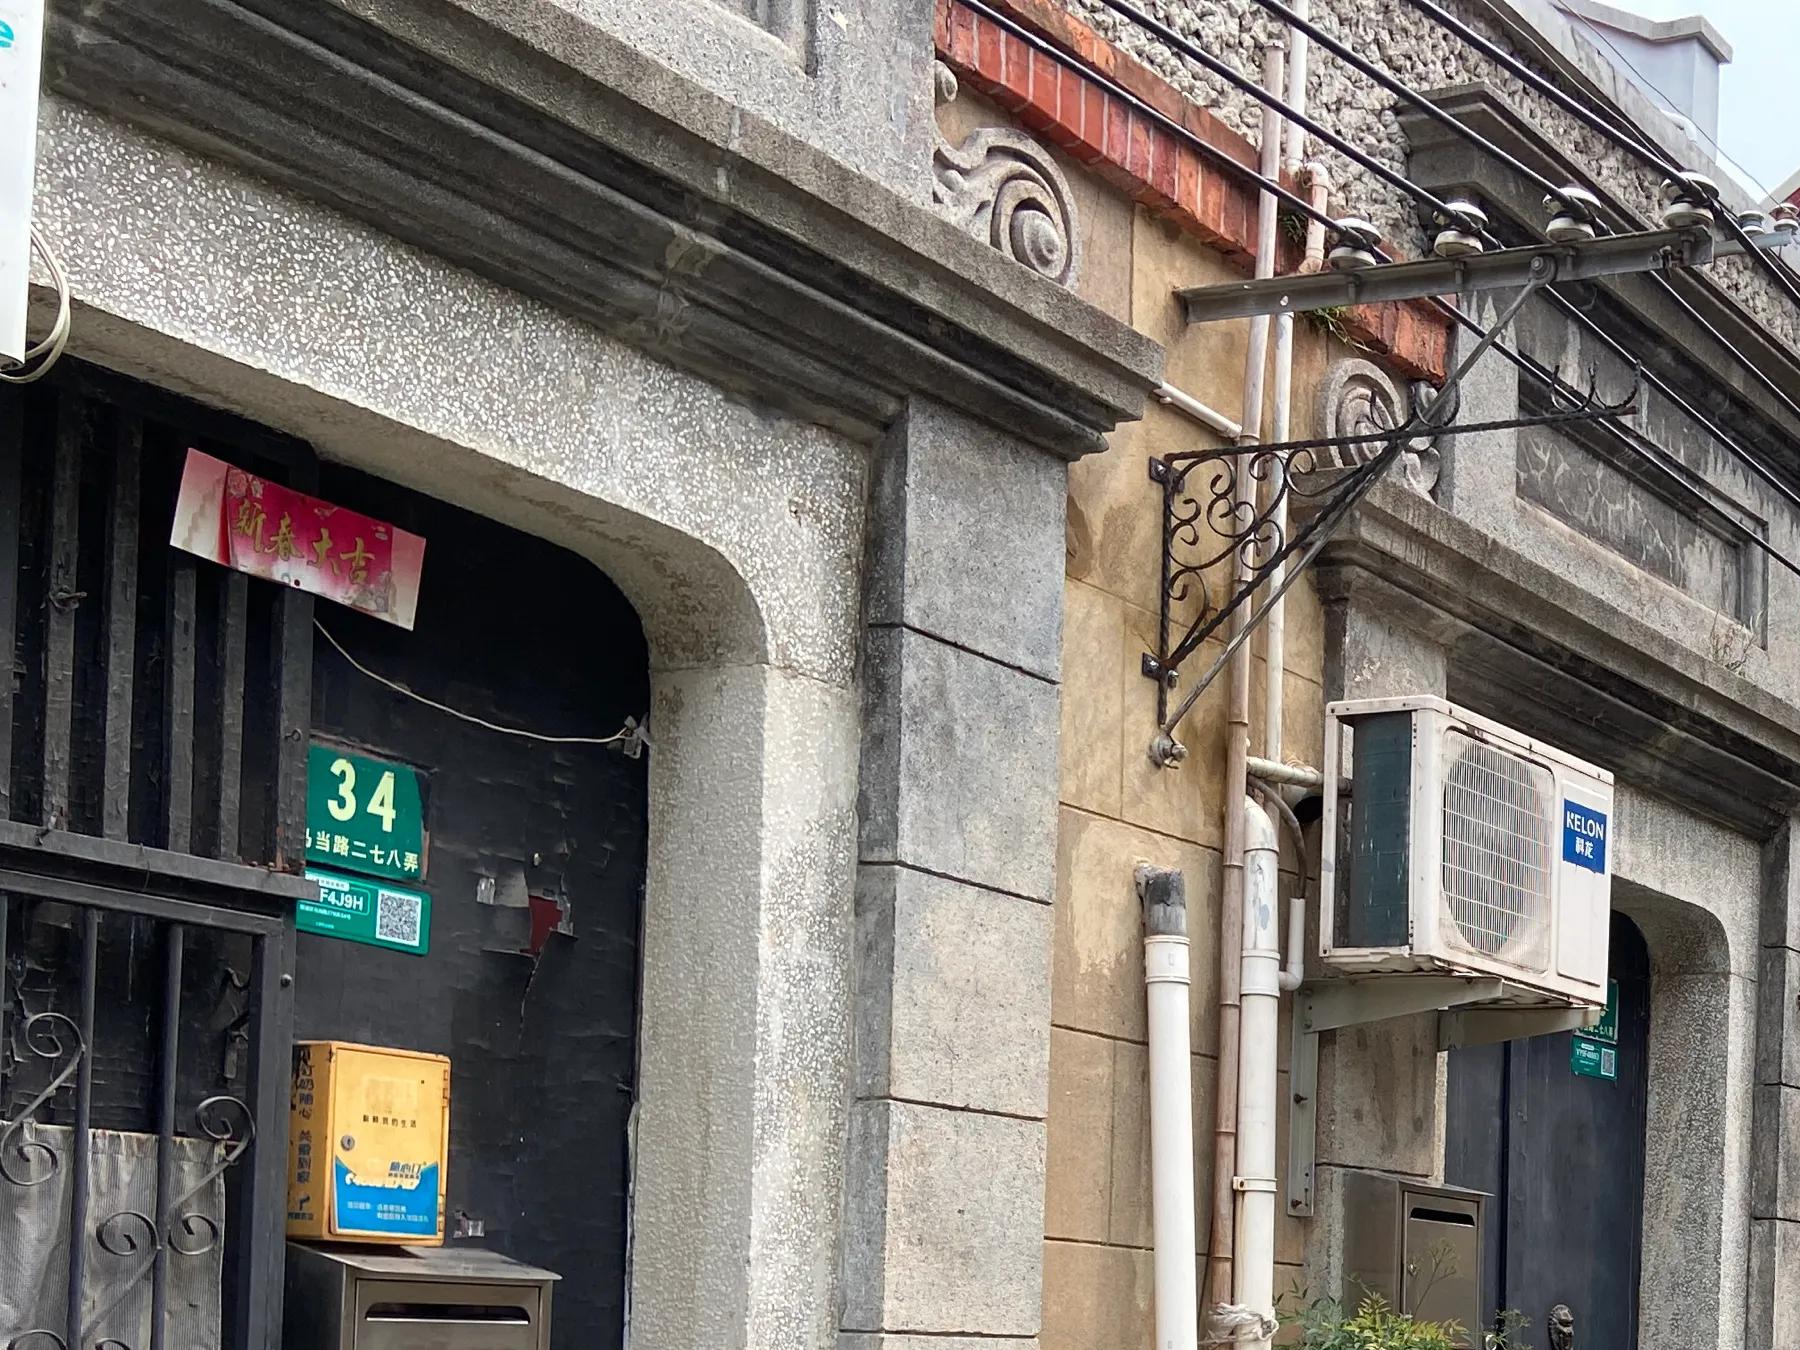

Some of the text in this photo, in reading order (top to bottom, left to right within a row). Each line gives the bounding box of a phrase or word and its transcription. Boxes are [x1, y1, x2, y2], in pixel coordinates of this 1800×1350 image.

[235, 499, 376, 585] 新春大吉
[327, 758, 397, 833] 34
[1566, 810, 1604, 841] KELON
[1575, 836, 1594, 859] 科龙
